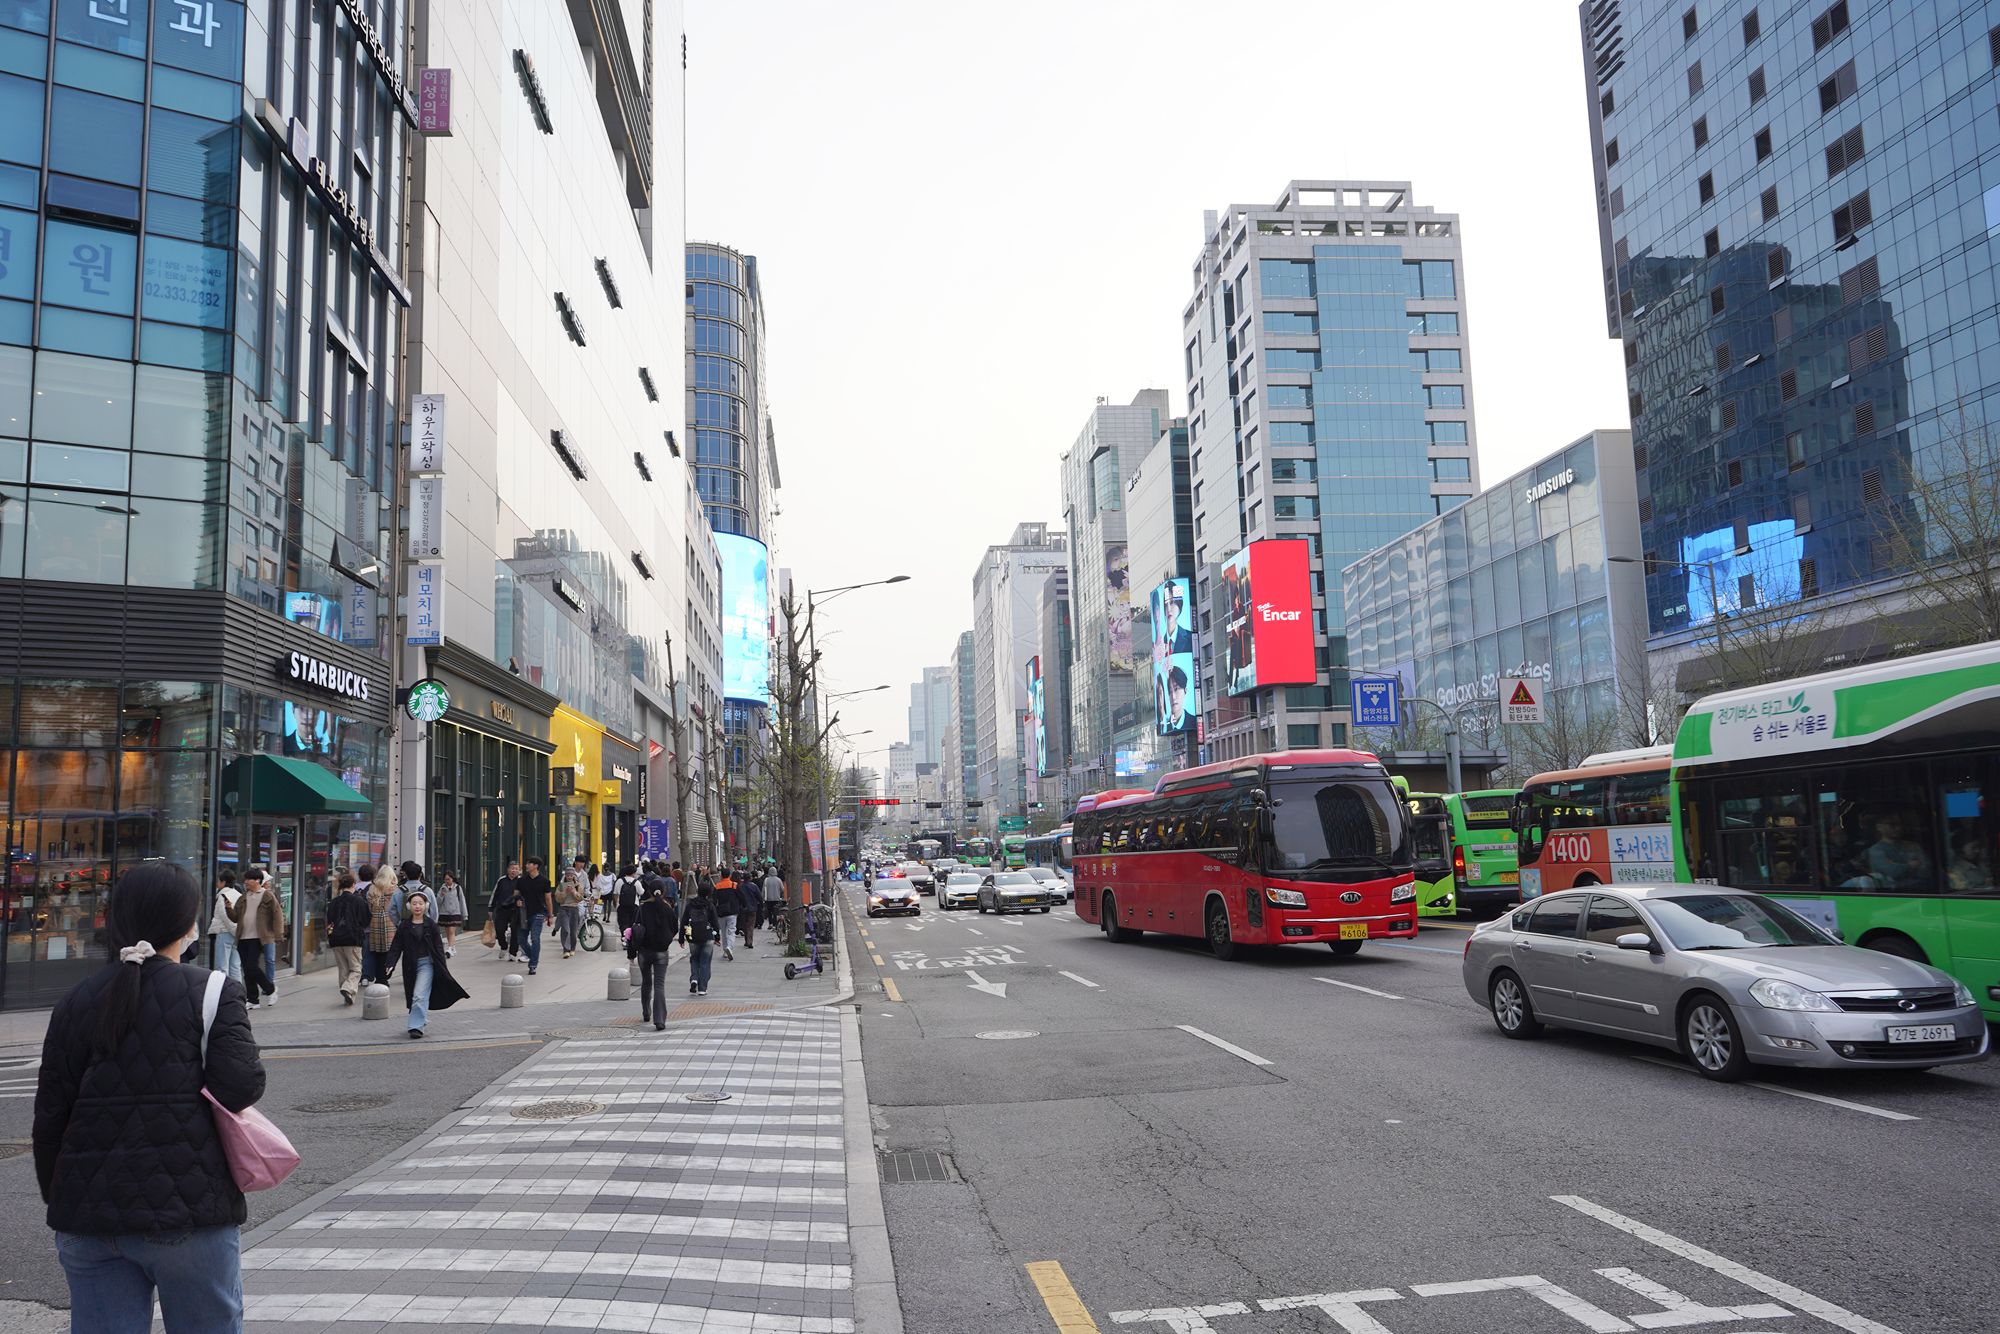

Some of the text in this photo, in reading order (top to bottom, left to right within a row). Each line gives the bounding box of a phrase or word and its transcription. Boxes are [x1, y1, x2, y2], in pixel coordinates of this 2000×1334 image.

[338, 0, 402, 101] 강의학과의원
[424, 71, 437, 129] 여성의원
[420, 402, 437, 469] 하우스왁싱
[1526, 468, 1573, 503] SAMSUNG
[416, 568, 433, 627] 네모치과
[1263, 610, 1301, 622] Encar
[290, 651, 368, 700] STARBUCKS
[1436, 681, 1480, 707] Galaxy
[1718, 700, 1783, 725] 전기버스 타고
[1753, 714, 1828, 742] 숨 쉬는 서울로
[1549, 836, 1591, 862] 1400
[1614, 834, 1670, 862] 독서인천
[1343, 893, 1360, 902] KIA
[1895, 1027, 1949, 1041] 27보 2691
